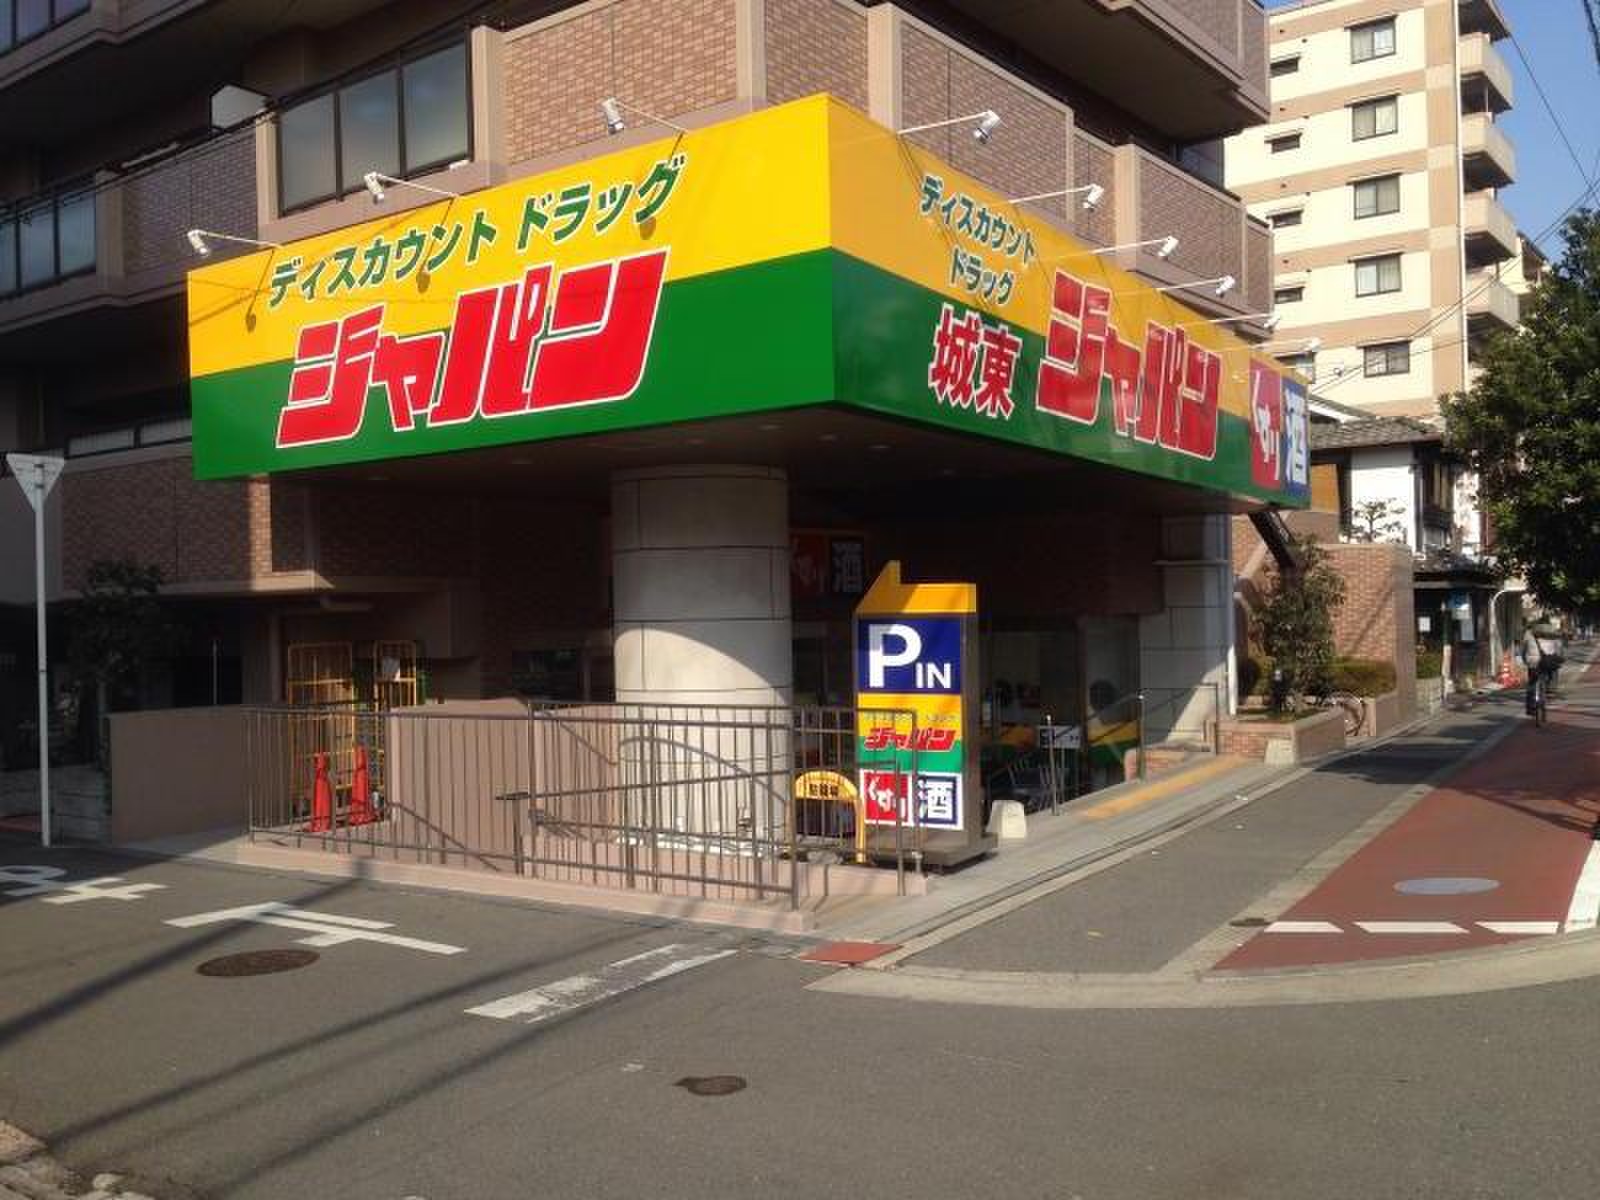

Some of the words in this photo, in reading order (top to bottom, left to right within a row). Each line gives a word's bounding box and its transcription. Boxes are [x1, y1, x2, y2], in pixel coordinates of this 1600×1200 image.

[268, 208, 498, 308] ディスカウント
[516, 153, 687, 250] ドラッグ
[921, 174, 1035, 268] ディスカウント
[949, 246, 1015, 305] ドラッグ
[928, 302, 1023, 420] 城東
[868, 623, 922, 689] P
[916, 662, 951, 689] IN
[917, 779, 954, 821] 酒
